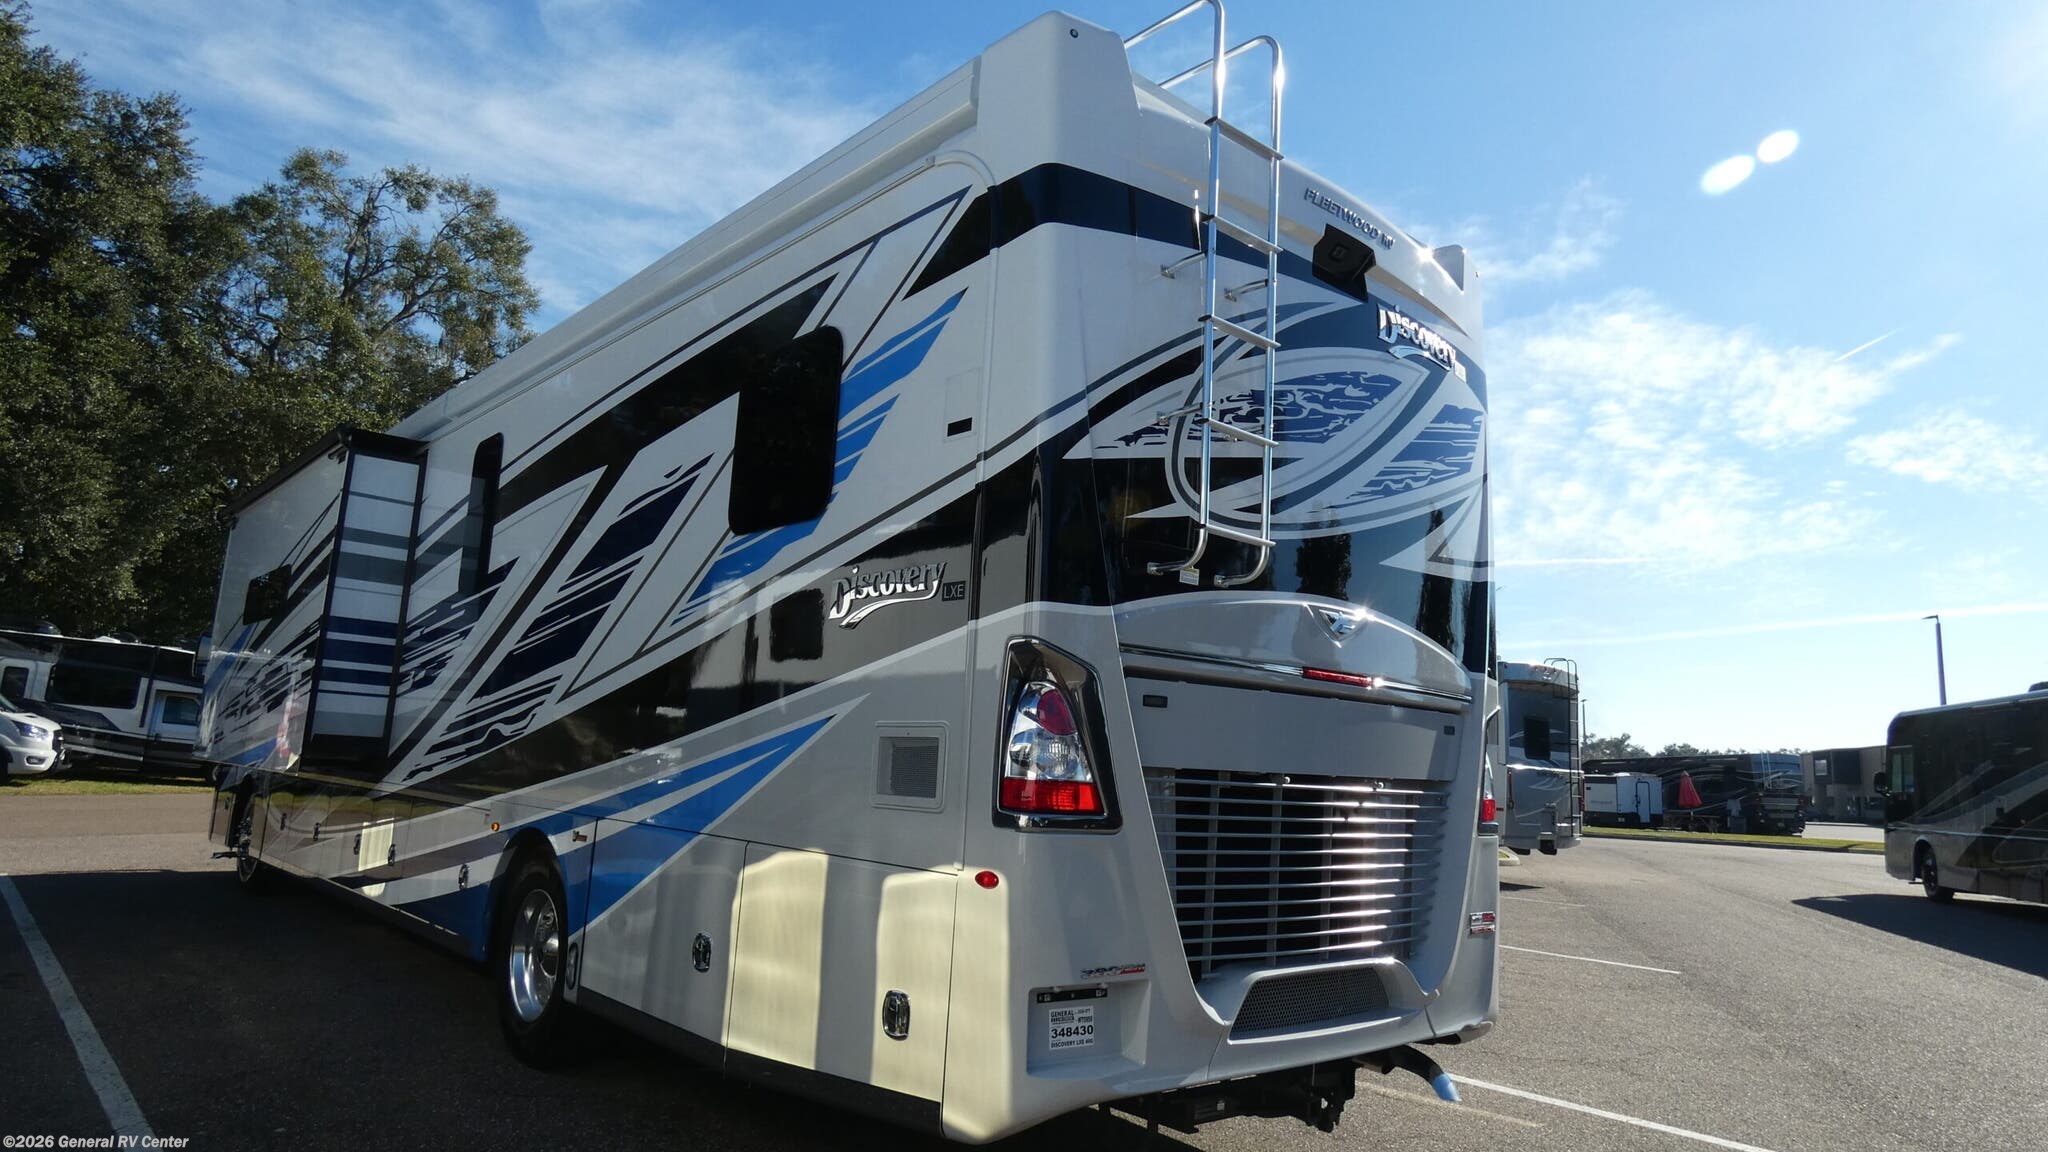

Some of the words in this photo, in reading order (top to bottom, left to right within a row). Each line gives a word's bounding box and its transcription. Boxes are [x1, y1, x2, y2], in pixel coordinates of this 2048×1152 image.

[1303, 187, 1380, 240] FLEETWOOD
[1376, 303, 1456, 372] Discovery
[828, 562, 947, 629] Discovery
[943, 583, 965, 599] LXE
[1051, 1024, 1094, 1039] 348430
[1051, 1040, 1075, 1049] DISCOVERY
